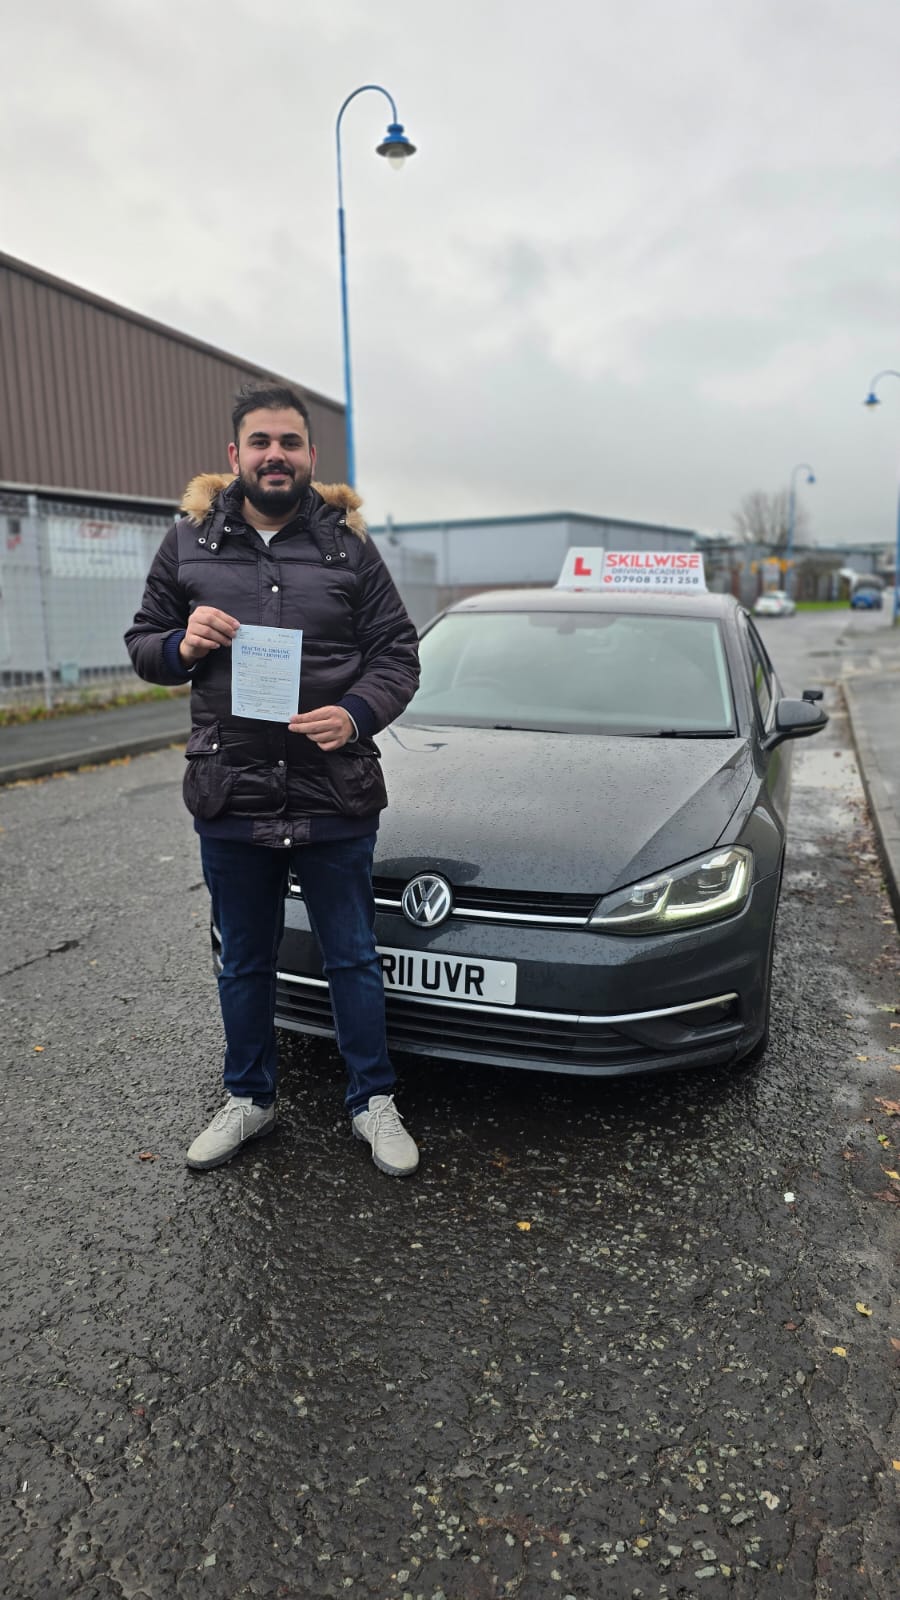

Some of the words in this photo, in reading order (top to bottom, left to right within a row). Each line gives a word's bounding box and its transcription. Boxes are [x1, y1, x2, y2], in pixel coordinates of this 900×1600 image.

[574, 556, 592, 576] L
[606, 554, 699, 568] SKILLWISE
[613, 576, 651, 584] 07908
[655, 576, 674, 584] 521
[678, 577, 699, 585] 258
[421, 958, 485, 996] UVR
